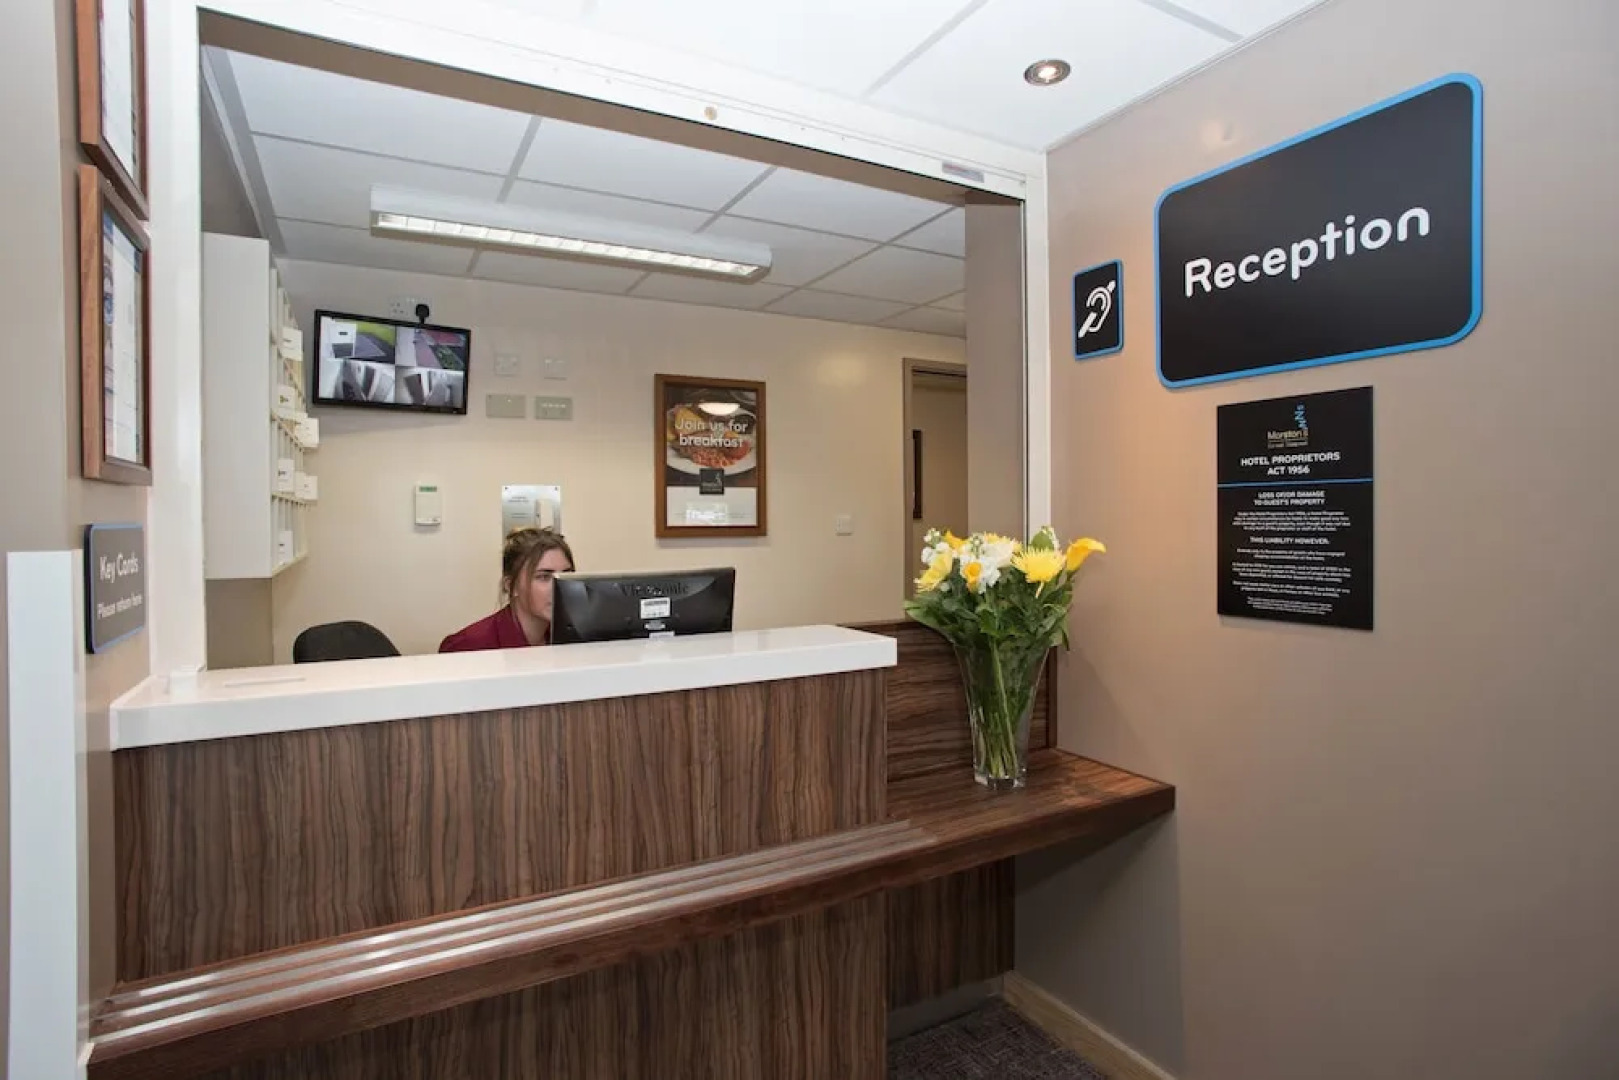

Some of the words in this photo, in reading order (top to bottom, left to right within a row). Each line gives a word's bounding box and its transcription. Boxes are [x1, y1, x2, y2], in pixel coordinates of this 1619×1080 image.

[1184, 206, 1431, 298] Reception
[675, 418, 705, 430] Join
[709, 420, 725, 431] us
[729, 420, 748, 432] for
[679, 433, 744, 448] breakfast
[1241, 457, 1270, 466] HOTEL
[1272, 452, 1340, 465] PROPRIETORS
[1267, 466, 1285, 476] ACT
[1287, 465, 1311, 475] 1956
[1297, 490, 1325, 498] DAMAGE
[100, 555, 116, 583] Key
[116, 552, 138, 576] Cards
[97, 602, 116, 620] Please
